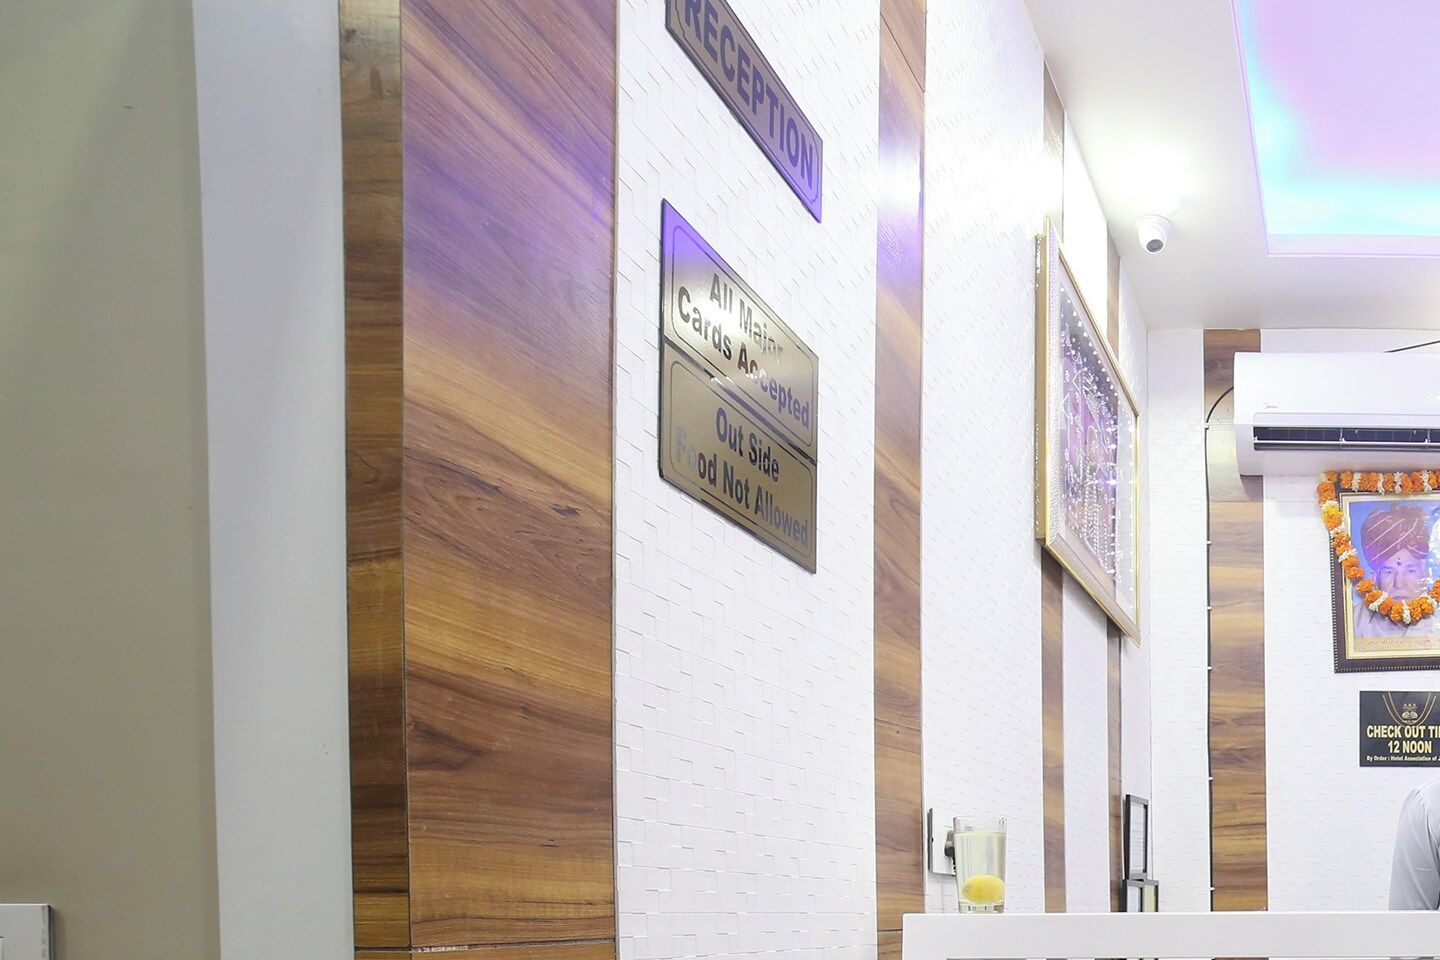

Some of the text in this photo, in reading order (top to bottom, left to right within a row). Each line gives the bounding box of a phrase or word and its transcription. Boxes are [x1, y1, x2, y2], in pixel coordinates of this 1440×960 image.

[685, 0, 812, 189] RECEPTION
[678, 286, 732, 360] Cards
[710, 273, 732, 314] All
[716, 408, 779, 482] Out Side
[723, 460, 749, 509] Not
[754, 485, 808, 548] Allowed
[1366, 725, 1402, 738] CHECK
[1404, 725, 1426, 738] OUT
[1388, 740, 1432, 753] 12 NOON
